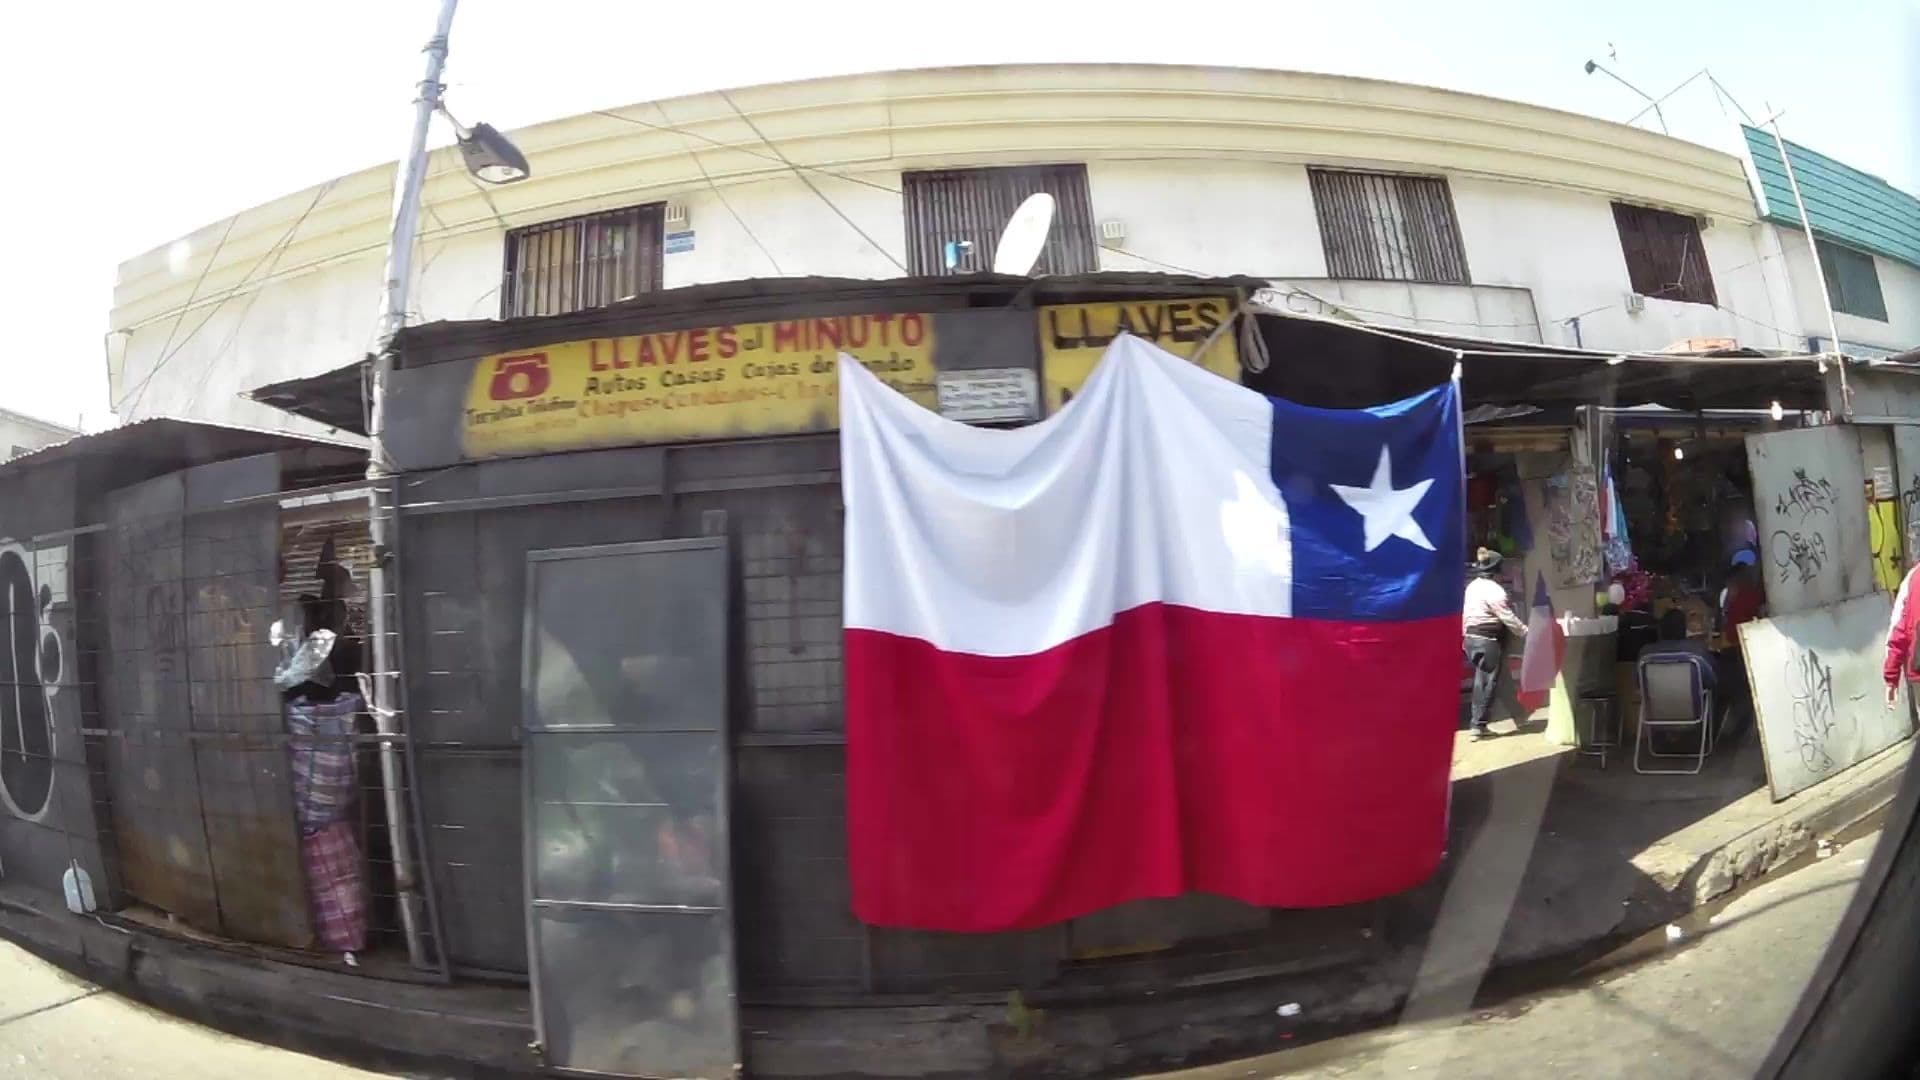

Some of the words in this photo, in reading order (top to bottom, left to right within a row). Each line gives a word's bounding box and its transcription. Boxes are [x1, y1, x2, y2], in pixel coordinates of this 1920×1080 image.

[588, 325, 739, 372] LLAVES
[773, 312, 924, 353] MINUTO
[1051, 302, 1219, 348] LLAVES
